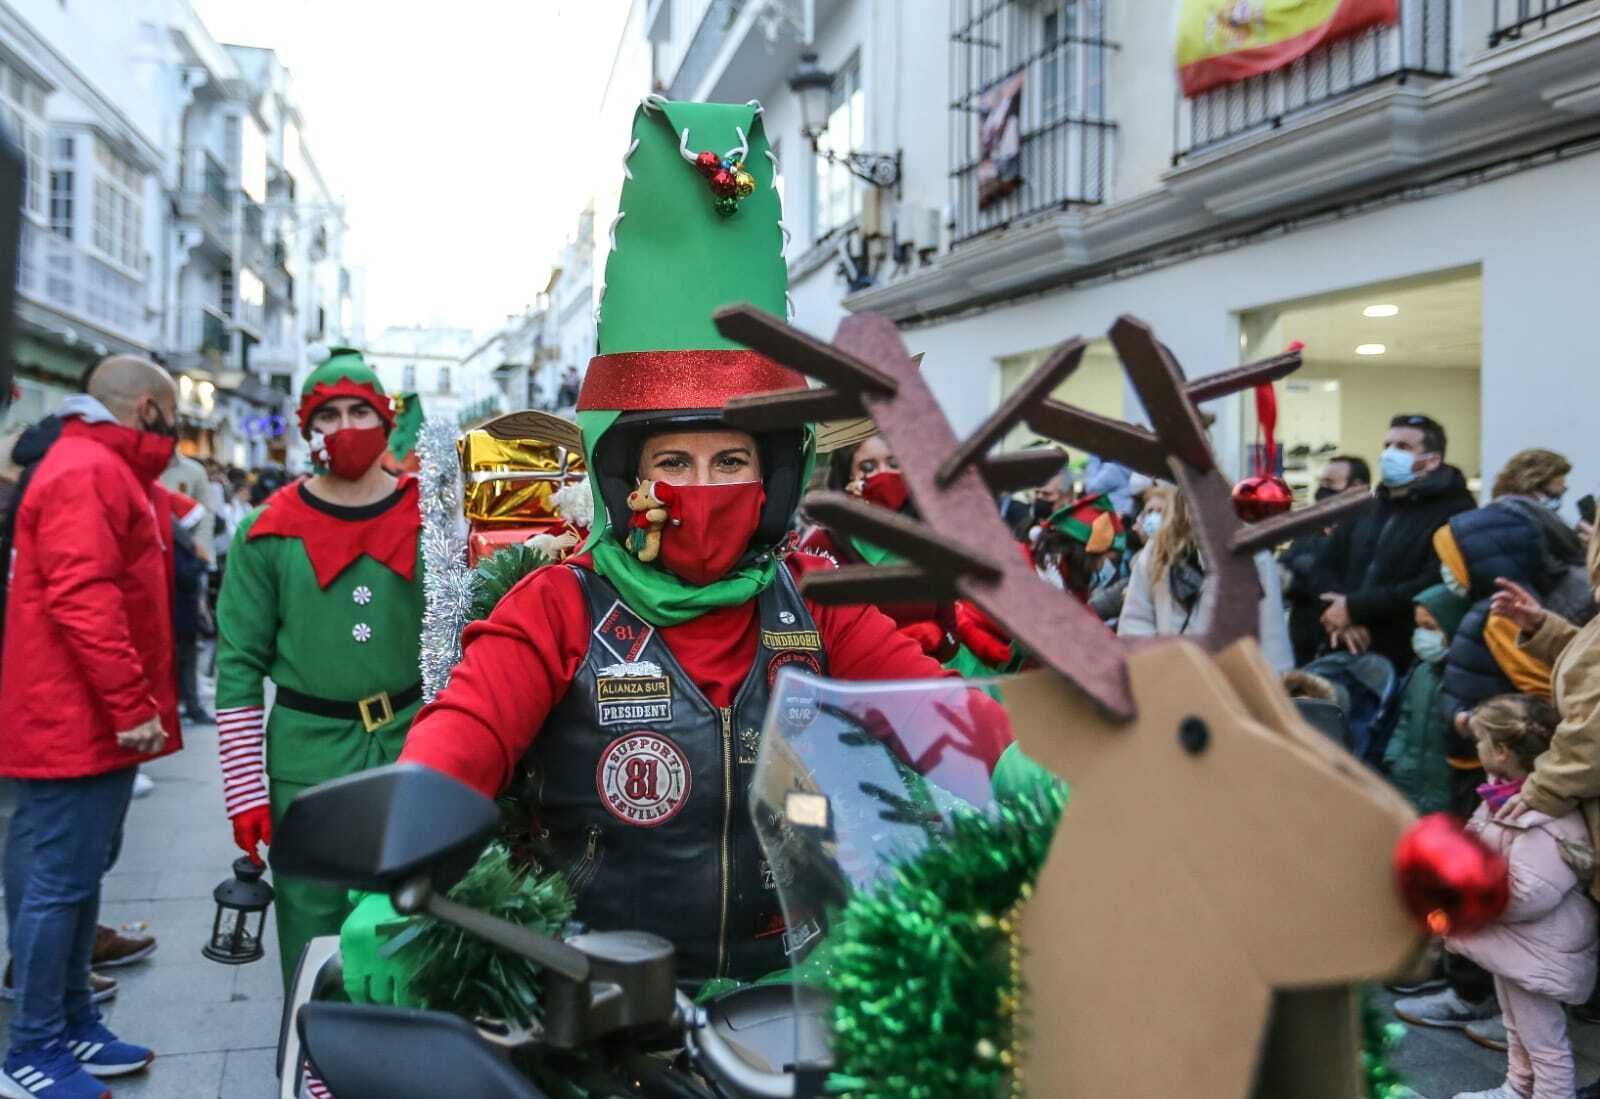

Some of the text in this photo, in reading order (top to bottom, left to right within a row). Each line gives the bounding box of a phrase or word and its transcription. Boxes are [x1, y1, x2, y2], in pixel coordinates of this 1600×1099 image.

[615, 625, 635, 640] 81
[602, 681, 666, 695] ALIANZA SUR
[603, 704, 667, 721] PRESIDENT
[609, 738, 681, 767] SUPPORT
[624, 758, 660, 801] 81
[608, 793, 679, 819] SEVILLA
